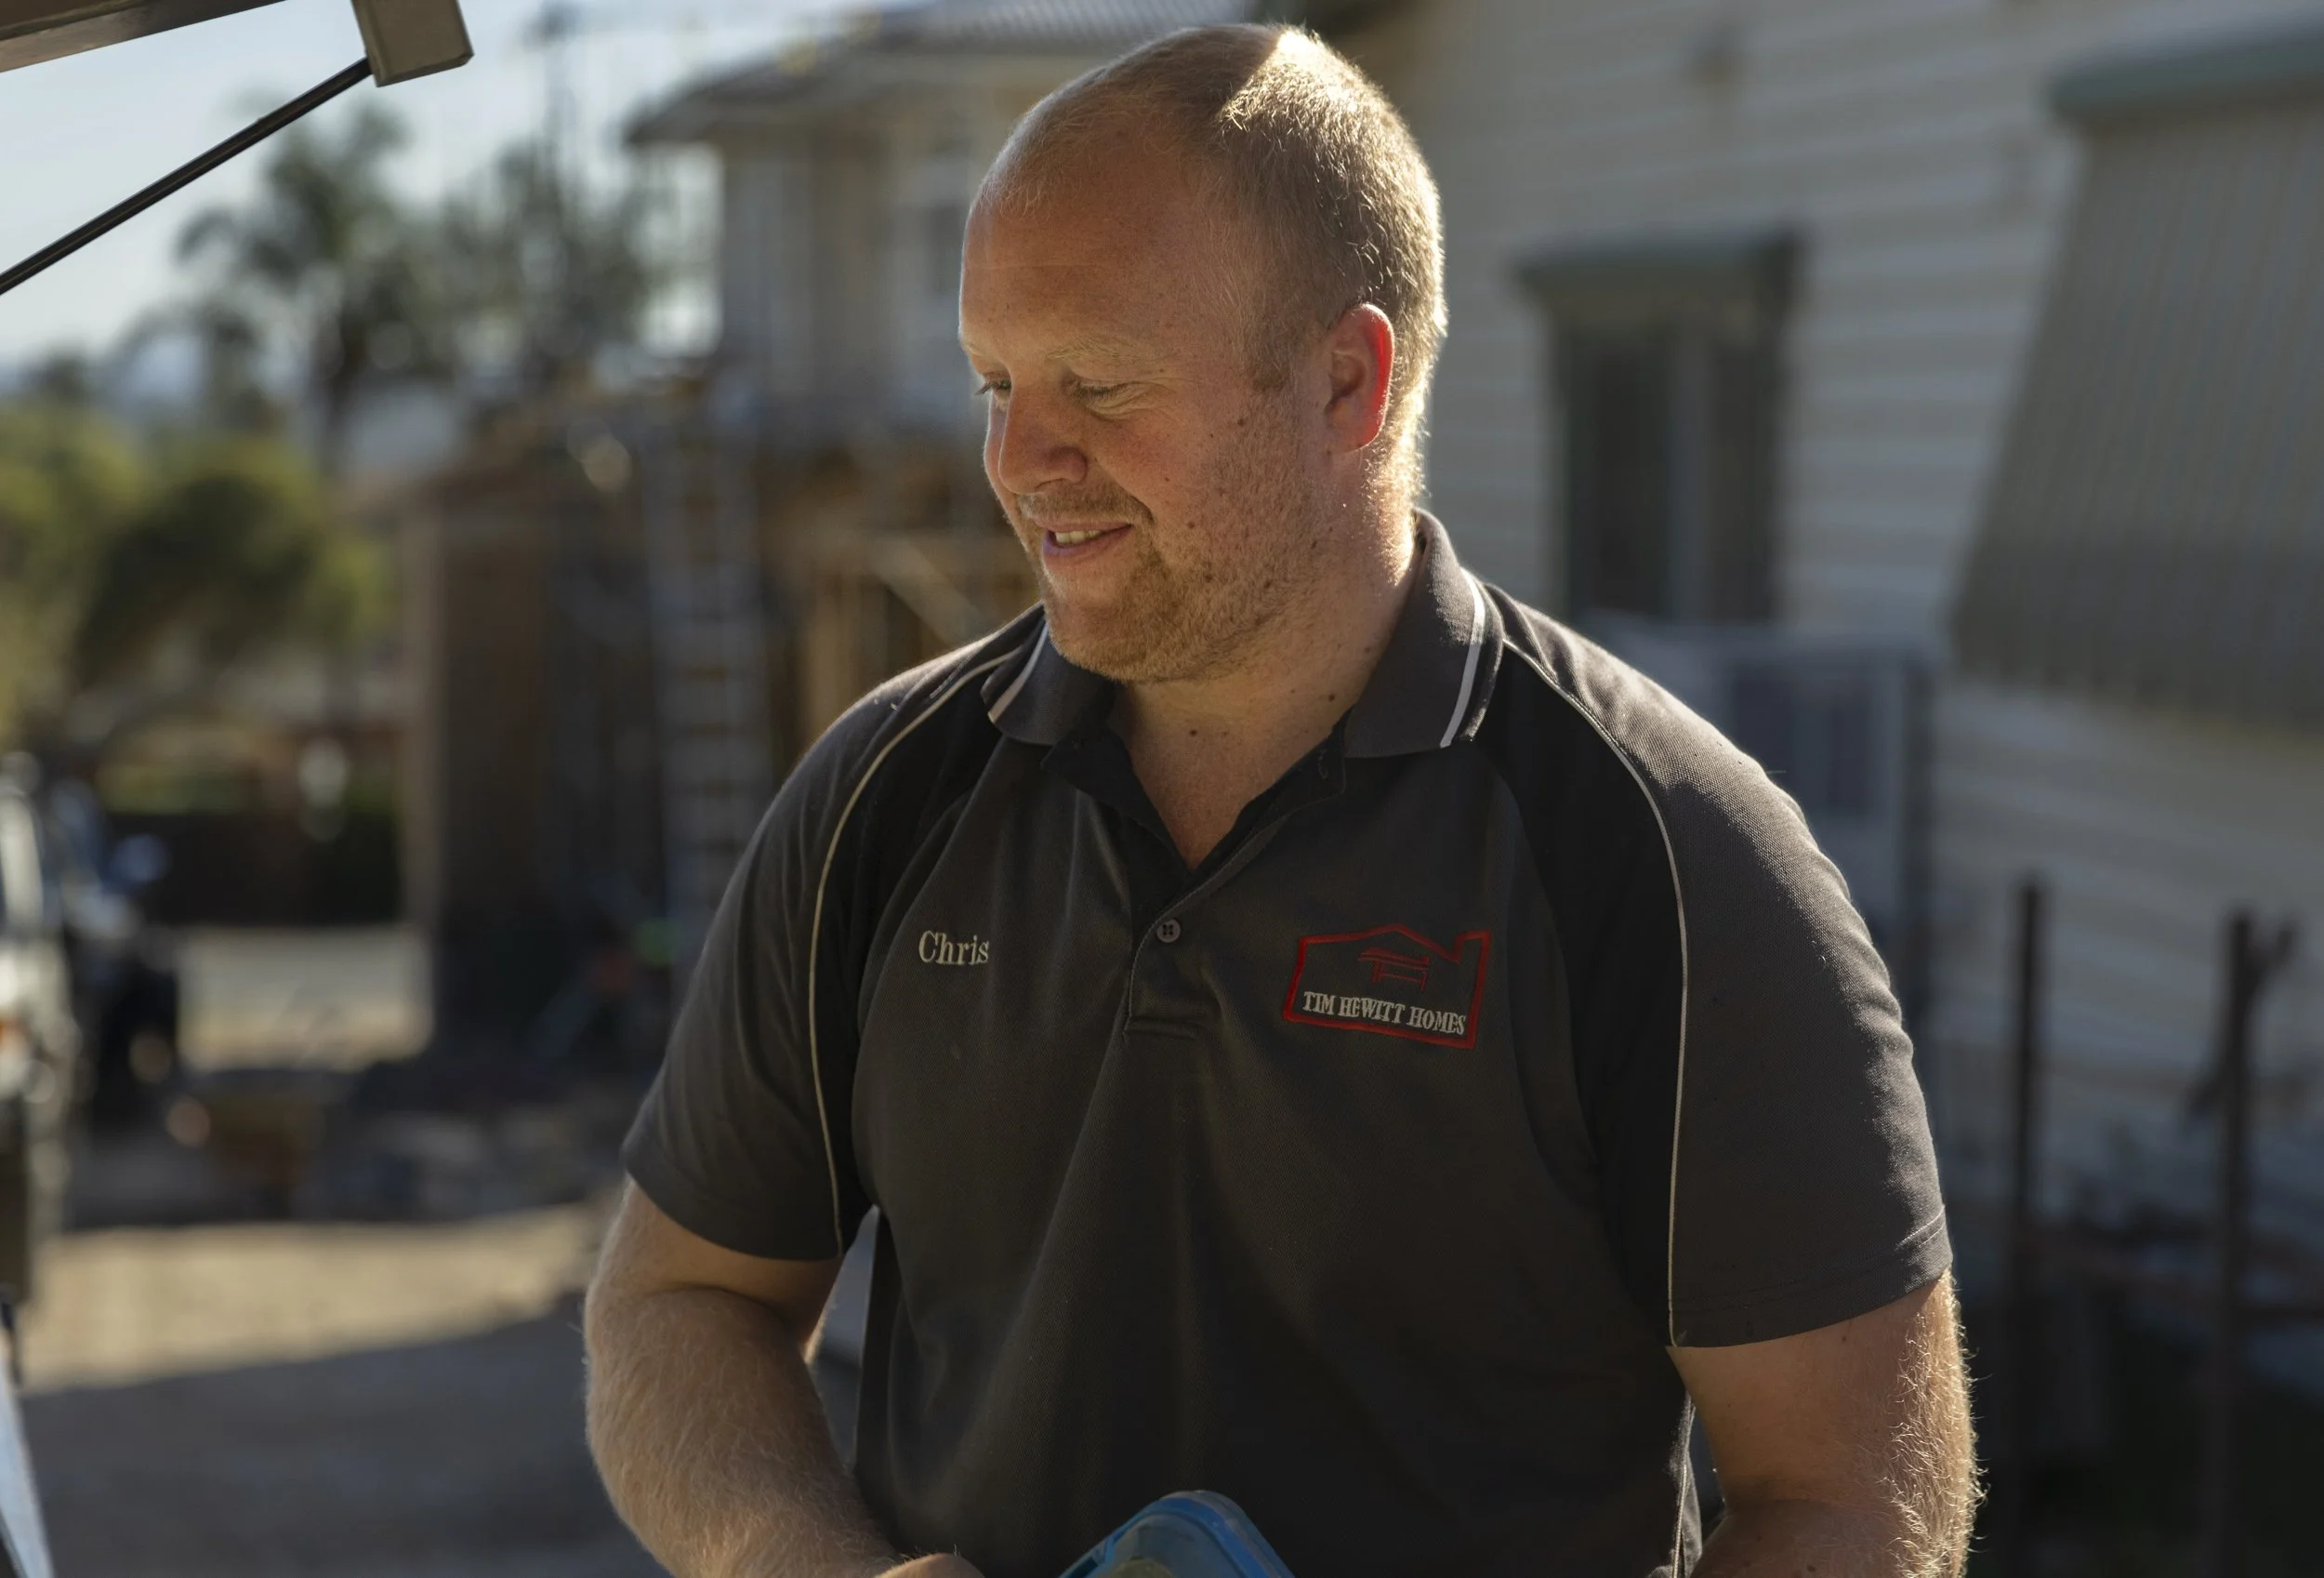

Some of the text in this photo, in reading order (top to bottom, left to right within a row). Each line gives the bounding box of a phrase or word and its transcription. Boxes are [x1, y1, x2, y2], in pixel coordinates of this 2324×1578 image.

[918, 930, 990, 965] Chris
[1302, 991, 1467, 1035] TIM HEWITT HOMES
